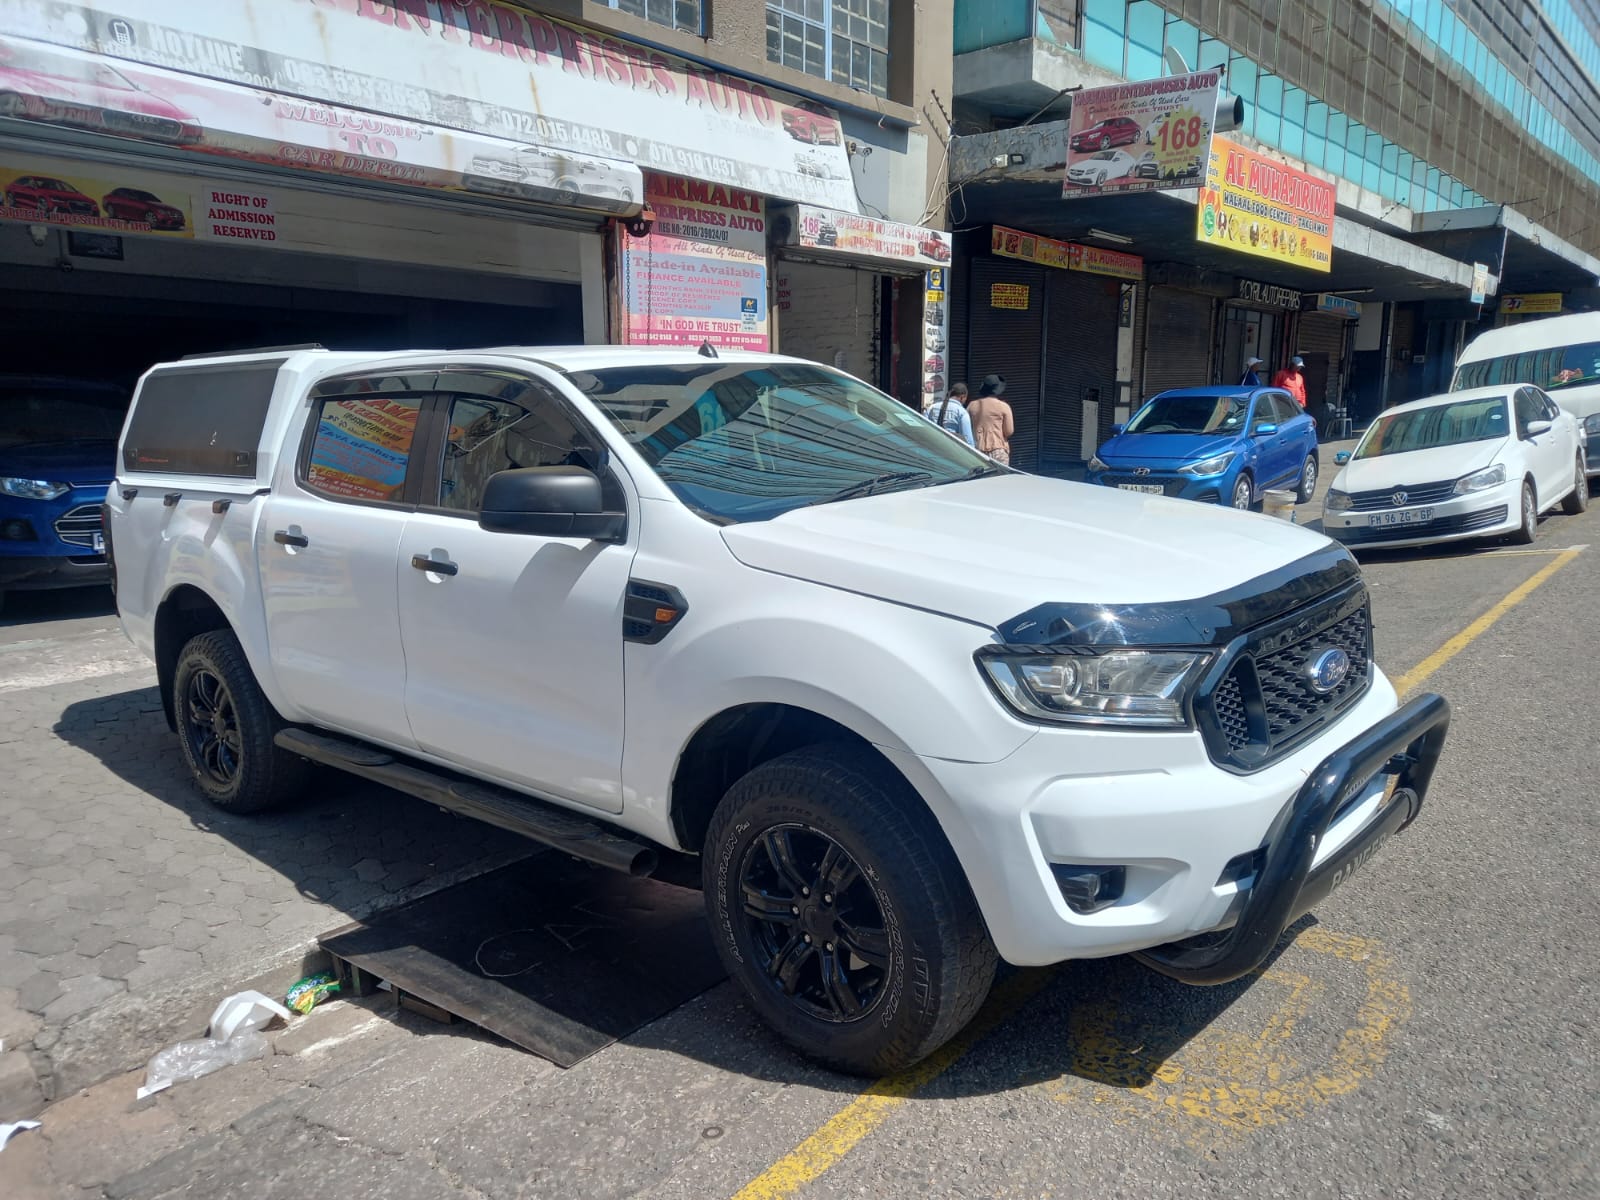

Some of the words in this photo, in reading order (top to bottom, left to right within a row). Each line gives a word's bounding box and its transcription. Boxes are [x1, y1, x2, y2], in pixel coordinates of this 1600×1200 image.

[684, 63, 775, 128] AUTO
[1186, 72, 1218, 89] AUTO
[277, 101, 420, 139] WELCOME
[1158, 116, 1201, 152] 168
[339, 131, 398, 161] TO
[278, 145, 336, 169] CAR
[342, 155, 425, 180] DEPOT
[1224, 149, 1247, 191] AL
[211, 191, 251, 206] RIGHT
[252, 196, 269, 209] OF
[646, 170, 762, 214] ARMART
[207, 208, 276, 226] ADMISSION
[652, 202, 728, 228] TERPRISES
[728, 211, 765, 234] AUTO
[803, 215, 820, 234] 168
[1252, 201, 1268, 219] FOOD
[212, 224, 277, 241] RESERVED
[690, 242, 715, 255] Kinds
[632, 256, 696, 273] Trade-in
[699, 263, 762, 280] Available
[636, 271, 685, 283] FINANCE
[687, 275, 742, 289] AVAILABLE
[674, 319, 694, 331] GOD
[696, 320, 711, 331] WE
[1384, 512, 1397, 523] 96
[1399, 511, 1412, 523] ZG
[1420, 508, 1433, 521] GP
[1326, 653, 1348, 683] Ford
[717, 831, 739, 921] TERRAIN
[721, 921, 744, 964] ALL
[877, 887, 906, 1029] SCORPION
